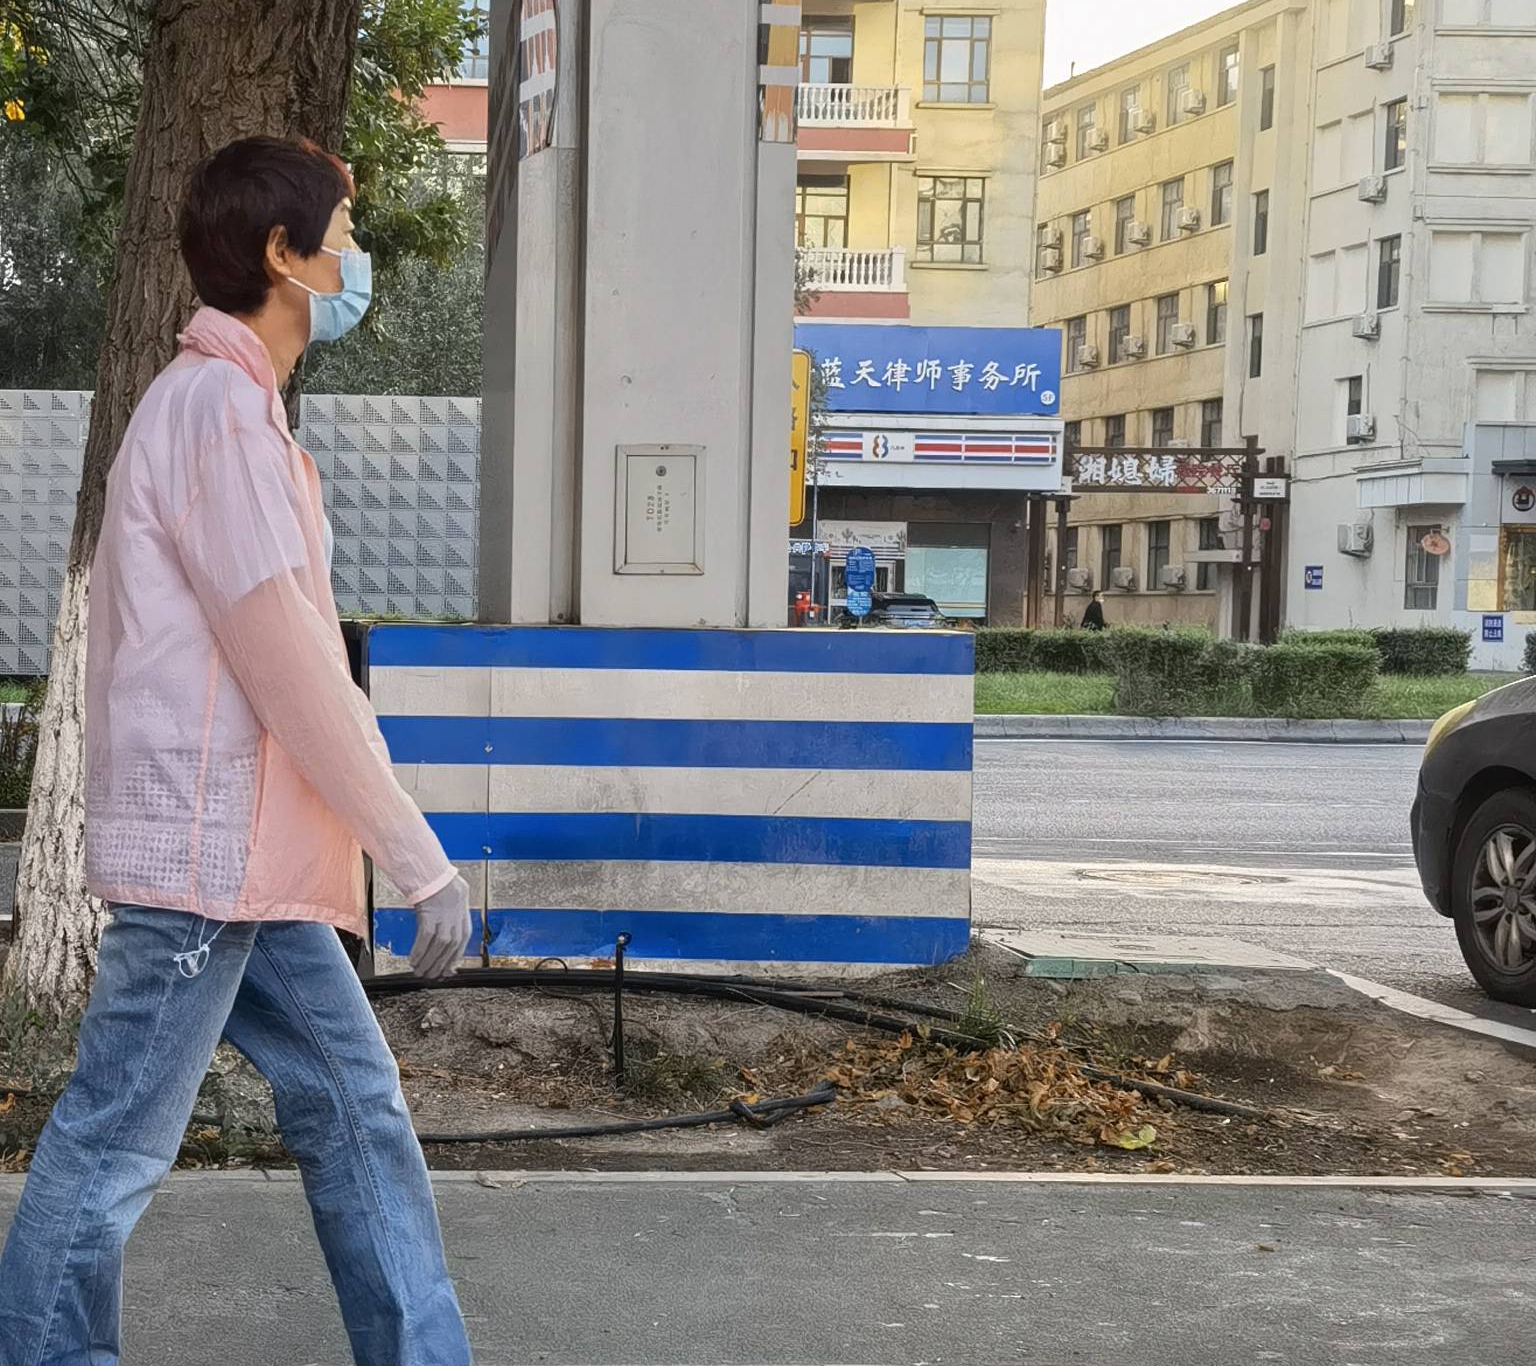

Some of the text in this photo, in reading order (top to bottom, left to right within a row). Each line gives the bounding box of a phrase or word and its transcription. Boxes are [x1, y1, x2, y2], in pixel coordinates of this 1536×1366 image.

[821, 357, 1042, 392] 蓝天律师事务所
